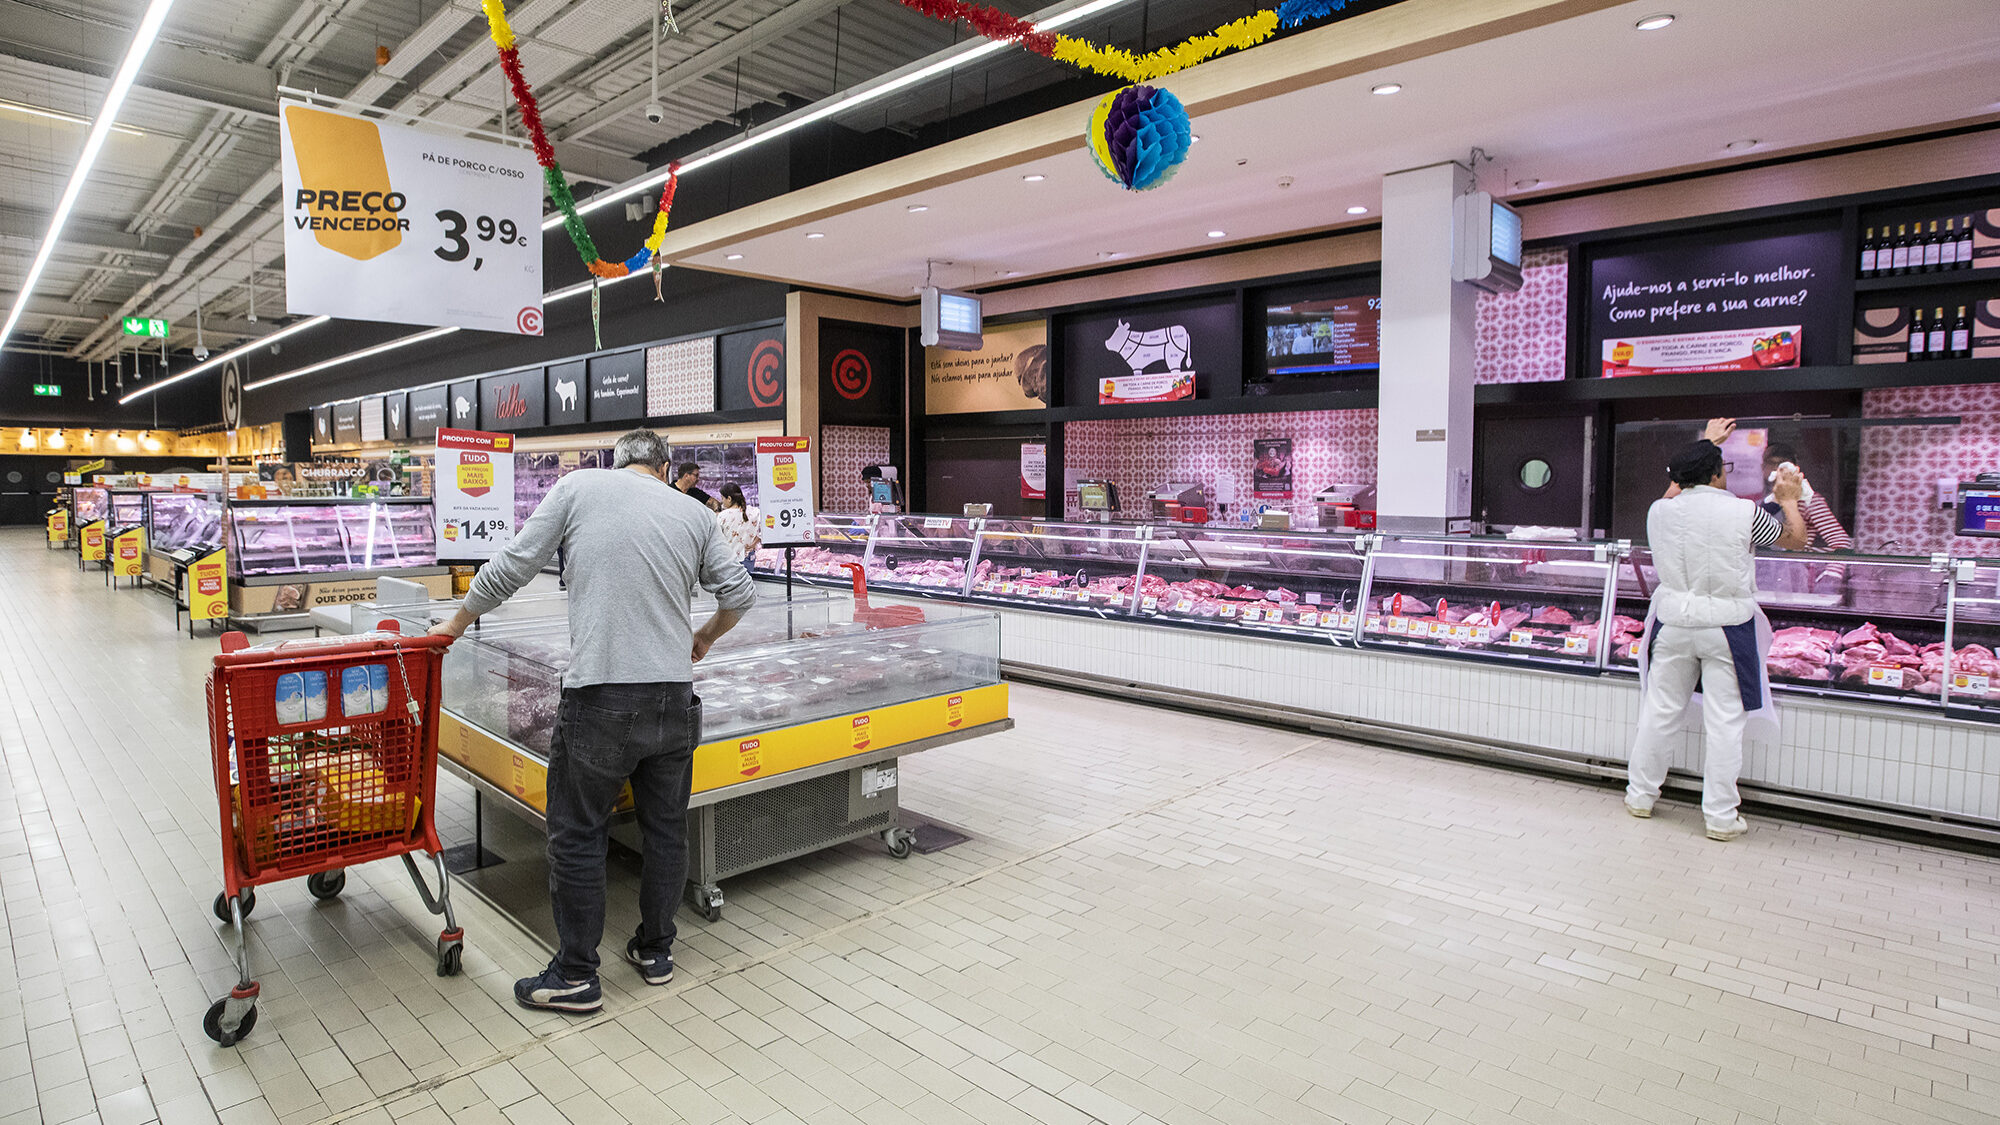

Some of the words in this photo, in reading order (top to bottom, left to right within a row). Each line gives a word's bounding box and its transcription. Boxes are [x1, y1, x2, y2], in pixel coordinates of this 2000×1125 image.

[422, 152, 435, 162] PÁ
[438, 156, 450, 166] DE
[453, 158, 486, 172] PORCO
[488, 166, 524, 180] C/OSSO
[296, 188, 406, 215] PREÇO
[294, 216, 410, 232] VENCEDOR
[524, 265, 534, 274] KG
[1602, 281, 1672, 304] Ajude-nos
[1676, 282, 1687, 292] a
[1692, 271, 1748, 292] servi-lo
[1754, 265, 1816, 284] melhor.
[1609, 306, 1646, 322] Como
[1650, 300, 1702, 323] prefere
[1706, 302, 1716, 313] a
[1722, 298, 1748, 312] sua
[1753, 290, 1808, 308] carne?
[971, 359, 984, 369] para
[990, 353, 1013, 367] jantar?
[942, 373, 962, 383] estamos
[964, 374, 976, 384] aqui
[978, 372, 991, 383] para
[993, 368, 1013, 382] ajudar
[494, 382, 528, 419] Talho
[442, 435, 475, 444] PRODUTO
[463, 454, 487, 462] TUDO
[301, 468, 366, 477] CHURRASCO
[315, 595, 336, 604] QUE
[339, 593, 365, 602] PODE
[855, 717, 868, 725] TUDO
[742, 741, 758, 750] TUDO
